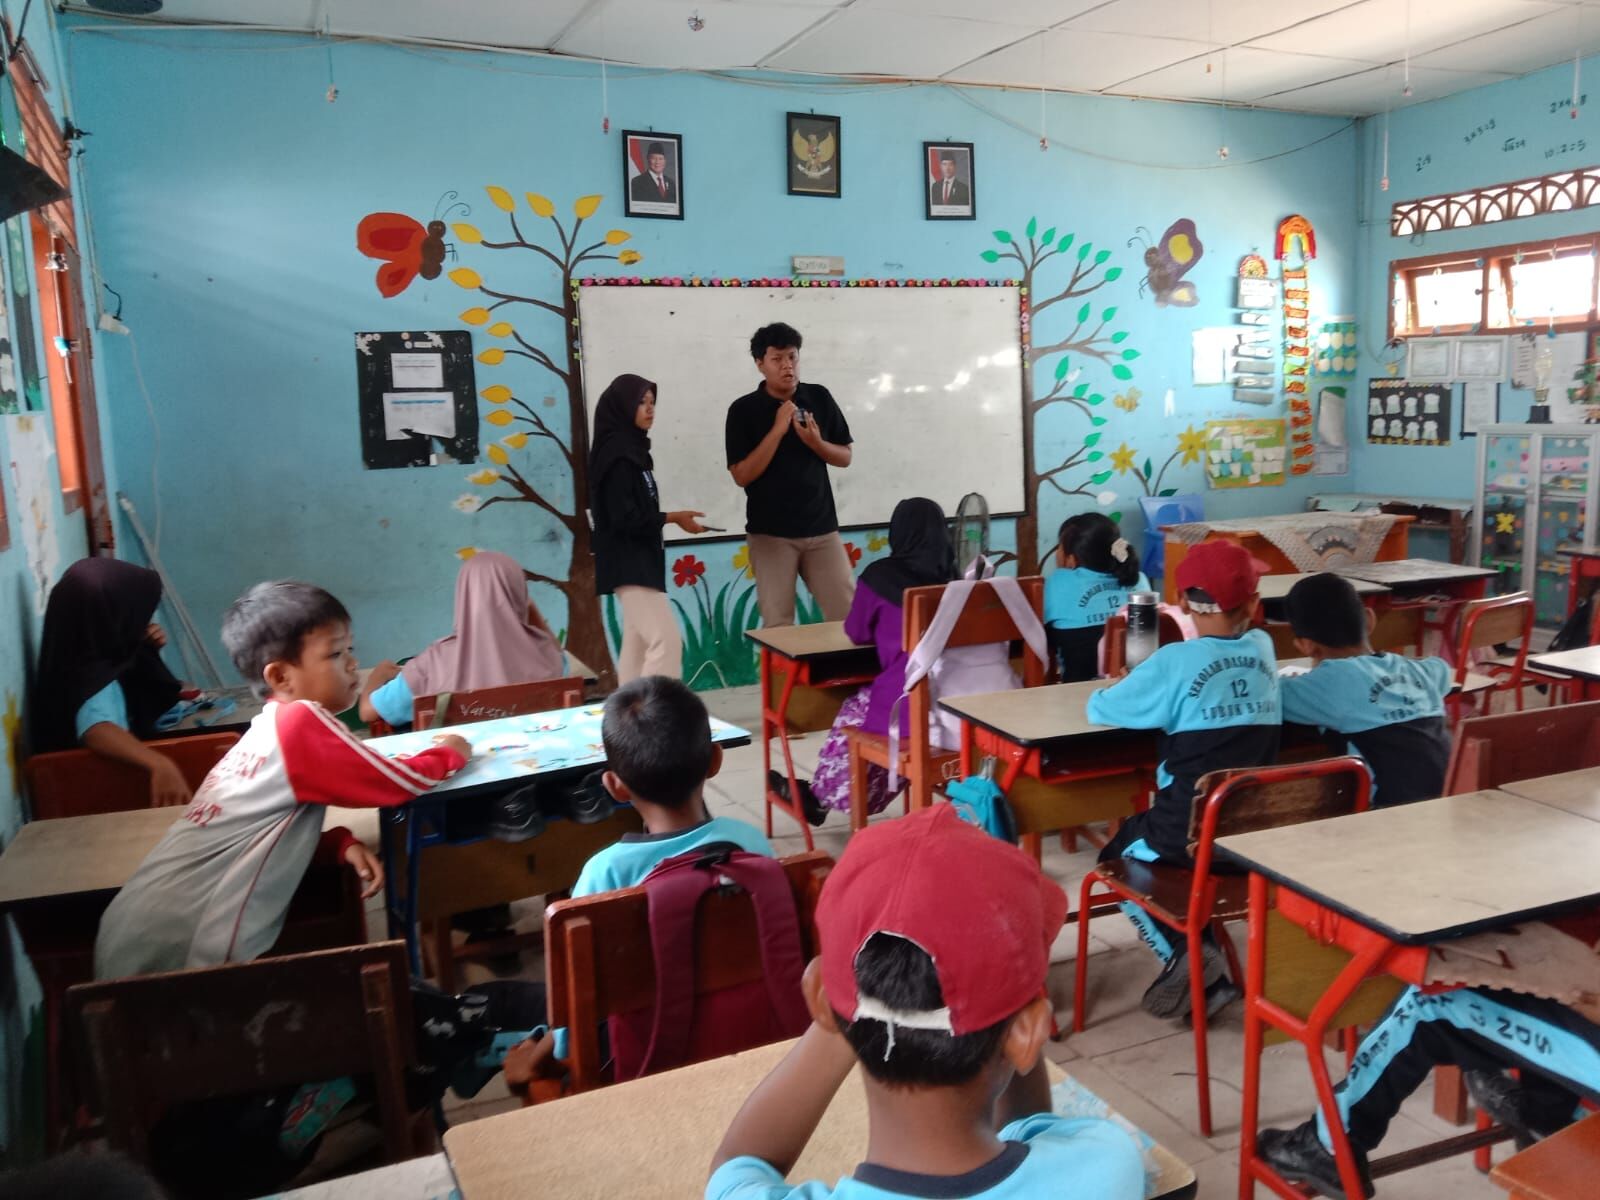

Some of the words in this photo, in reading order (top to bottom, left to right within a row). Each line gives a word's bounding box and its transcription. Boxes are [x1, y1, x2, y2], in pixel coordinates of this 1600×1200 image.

[1107, 595, 1120, 609] 12
[1187, 660, 1223, 699] SEKOLAH
[1230, 678, 1250, 699] 12
